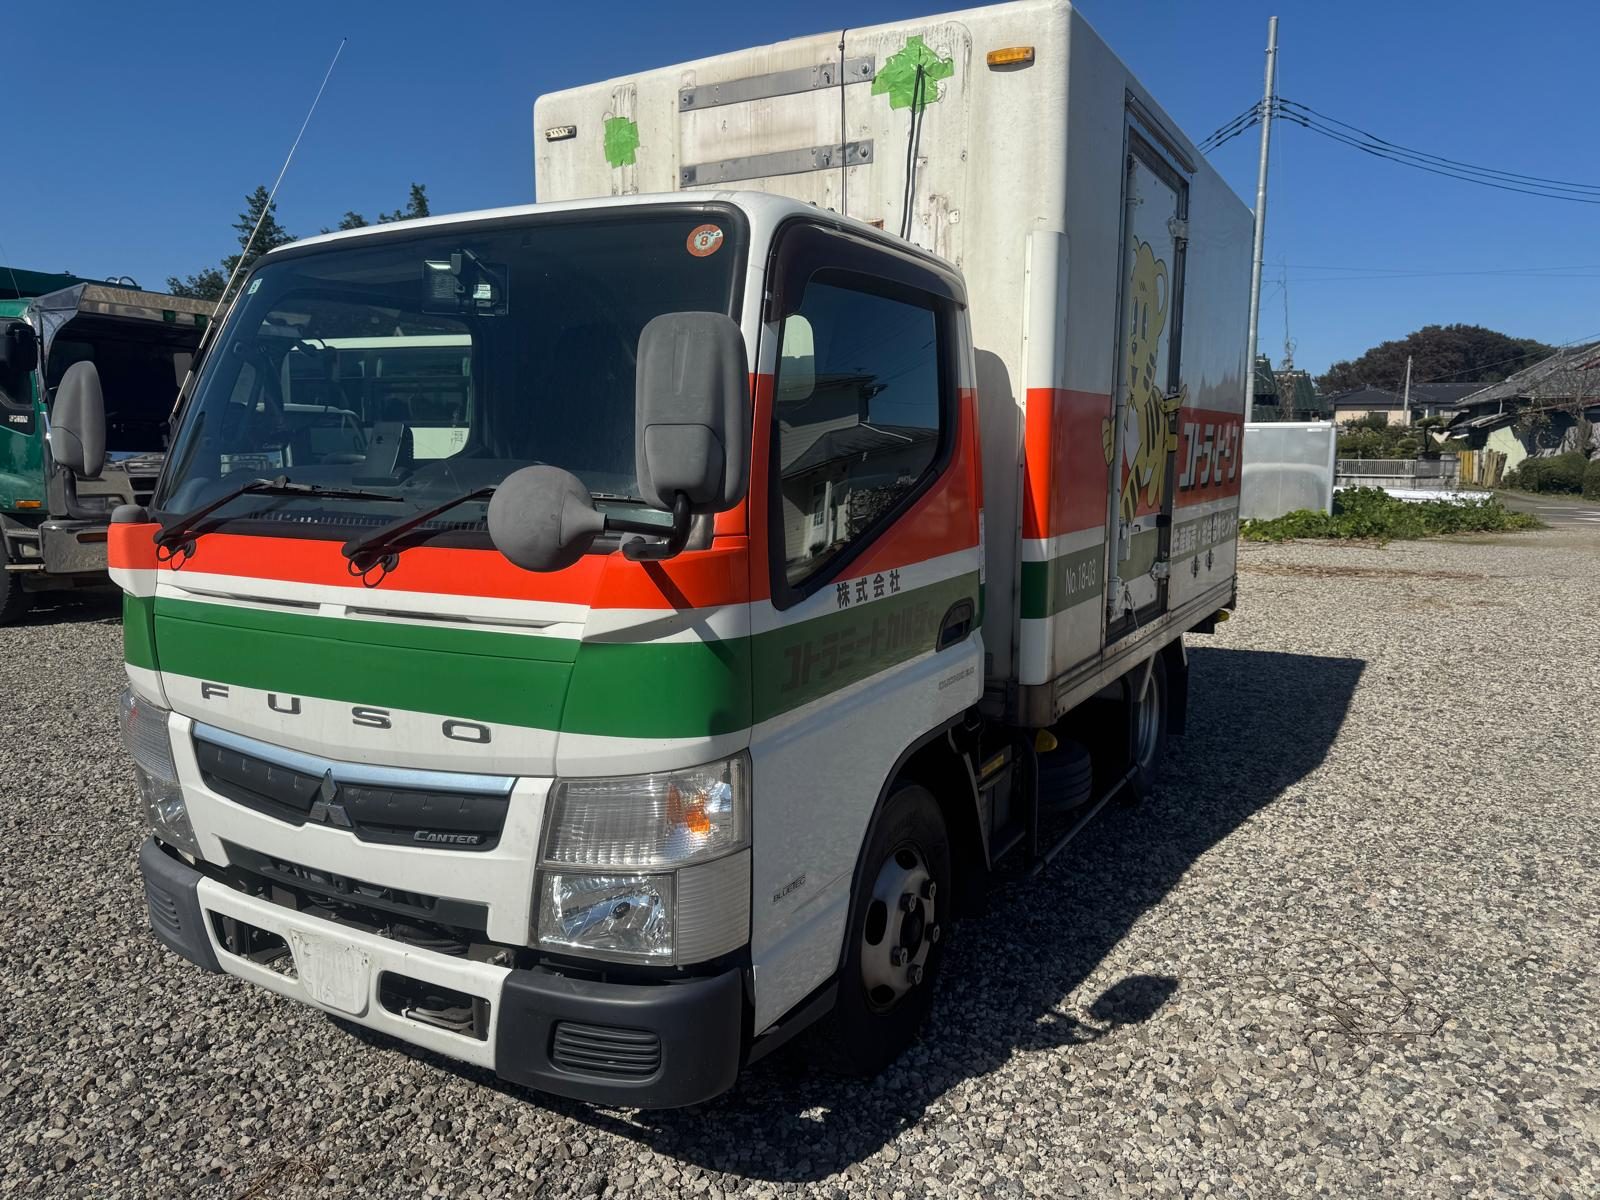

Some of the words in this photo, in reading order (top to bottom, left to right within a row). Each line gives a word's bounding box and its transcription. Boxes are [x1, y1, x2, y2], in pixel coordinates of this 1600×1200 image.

[836, 569, 901, 608] 株式会社
[1065, 558, 1096, 596] No.18-03
[201, 681, 492, 744] FUSO
[413, 830, 480, 845] CANTER
